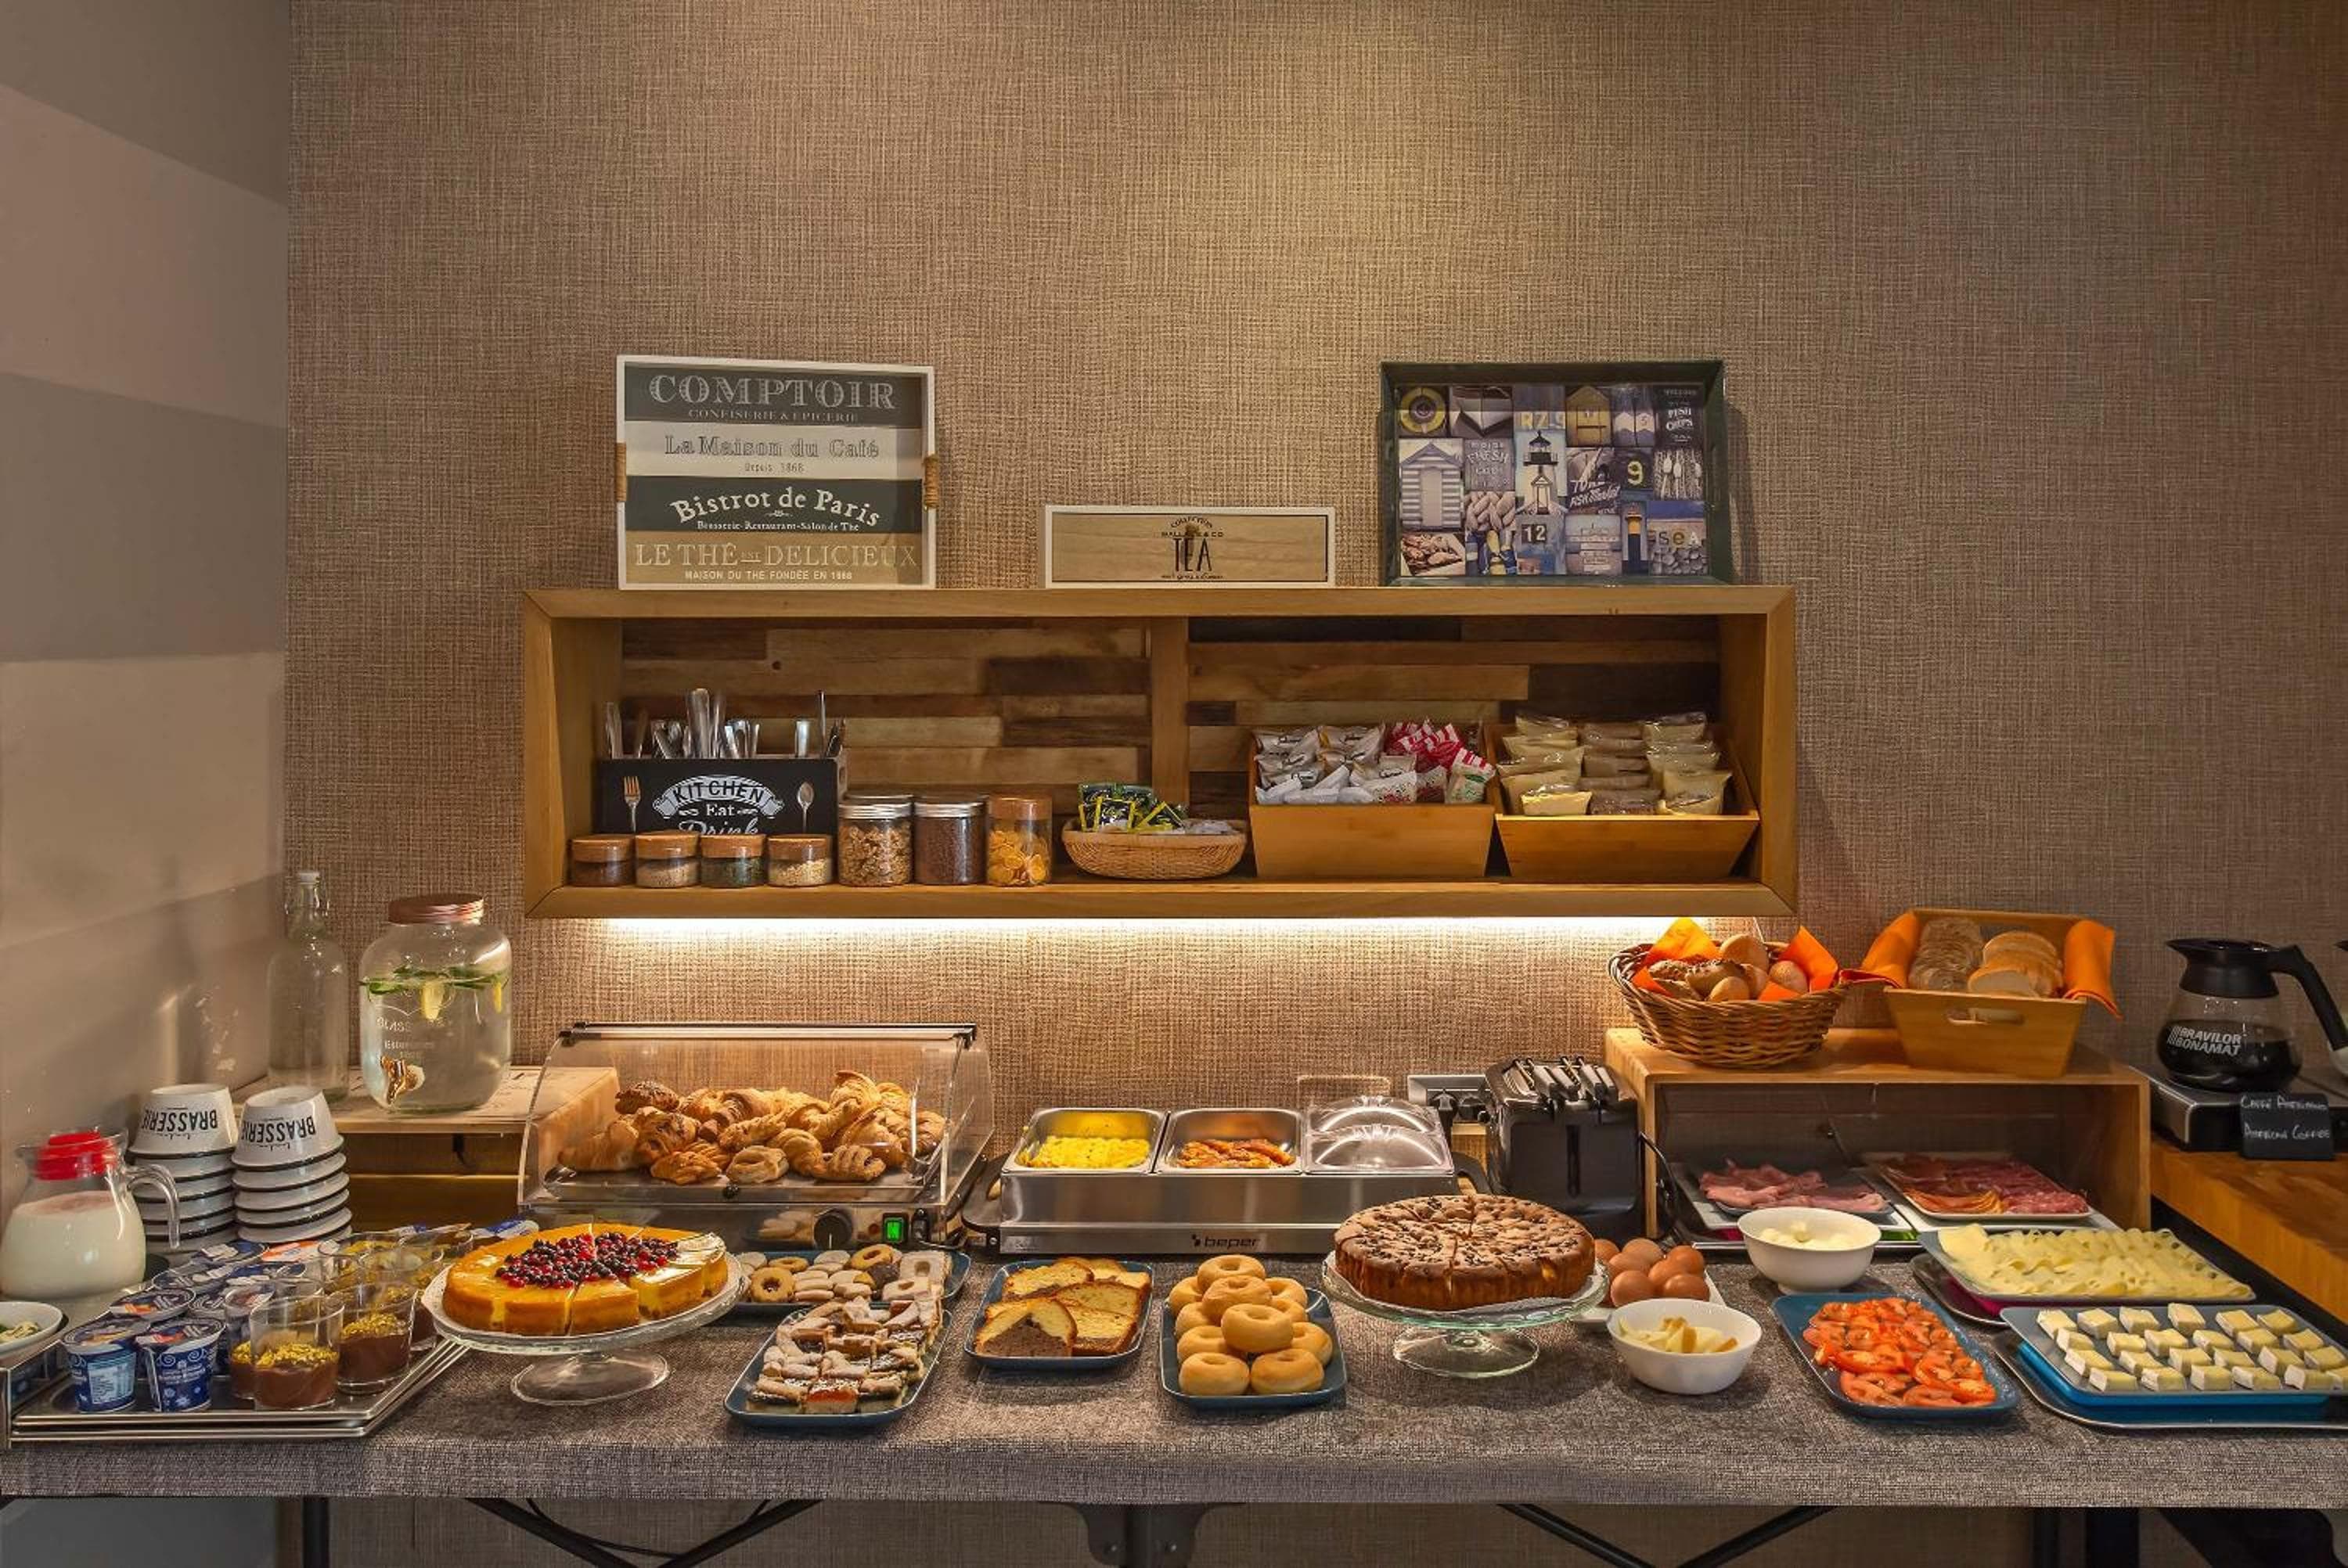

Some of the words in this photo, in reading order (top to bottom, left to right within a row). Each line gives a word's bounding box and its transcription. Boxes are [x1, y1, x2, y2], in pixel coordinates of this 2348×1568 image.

[649, 375, 896, 409] COMPTOIR
[664, 435, 694, 455] La
[698, 435, 783, 457] Maison
[790, 437, 819, 458] du
[829, 438, 879, 459] Café
[1626, 460, 1644, 486] 9
[669, 492, 770, 523] Bistrot
[779, 486, 807, 509] de
[814, 489, 880, 527] Paris
[1524, 524, 1547, 542] 12
[635, 544, 671, 566] LE
[1172, 538, 1212, 572] TEA
[685, 570, 724, 581] MAISON
[728, 570, 742, 581] DU
[813, 570, 827, 581] EN
[672, 780, 765, 803] KITCHEN
[706, 804, 736, 816] Eat
[2175, 1037, 2241, 1057] BONAMAT
[2179, 1027, 2242, 1045] BRAVILOR
[1205, 1235, 1261, 1250] beper
